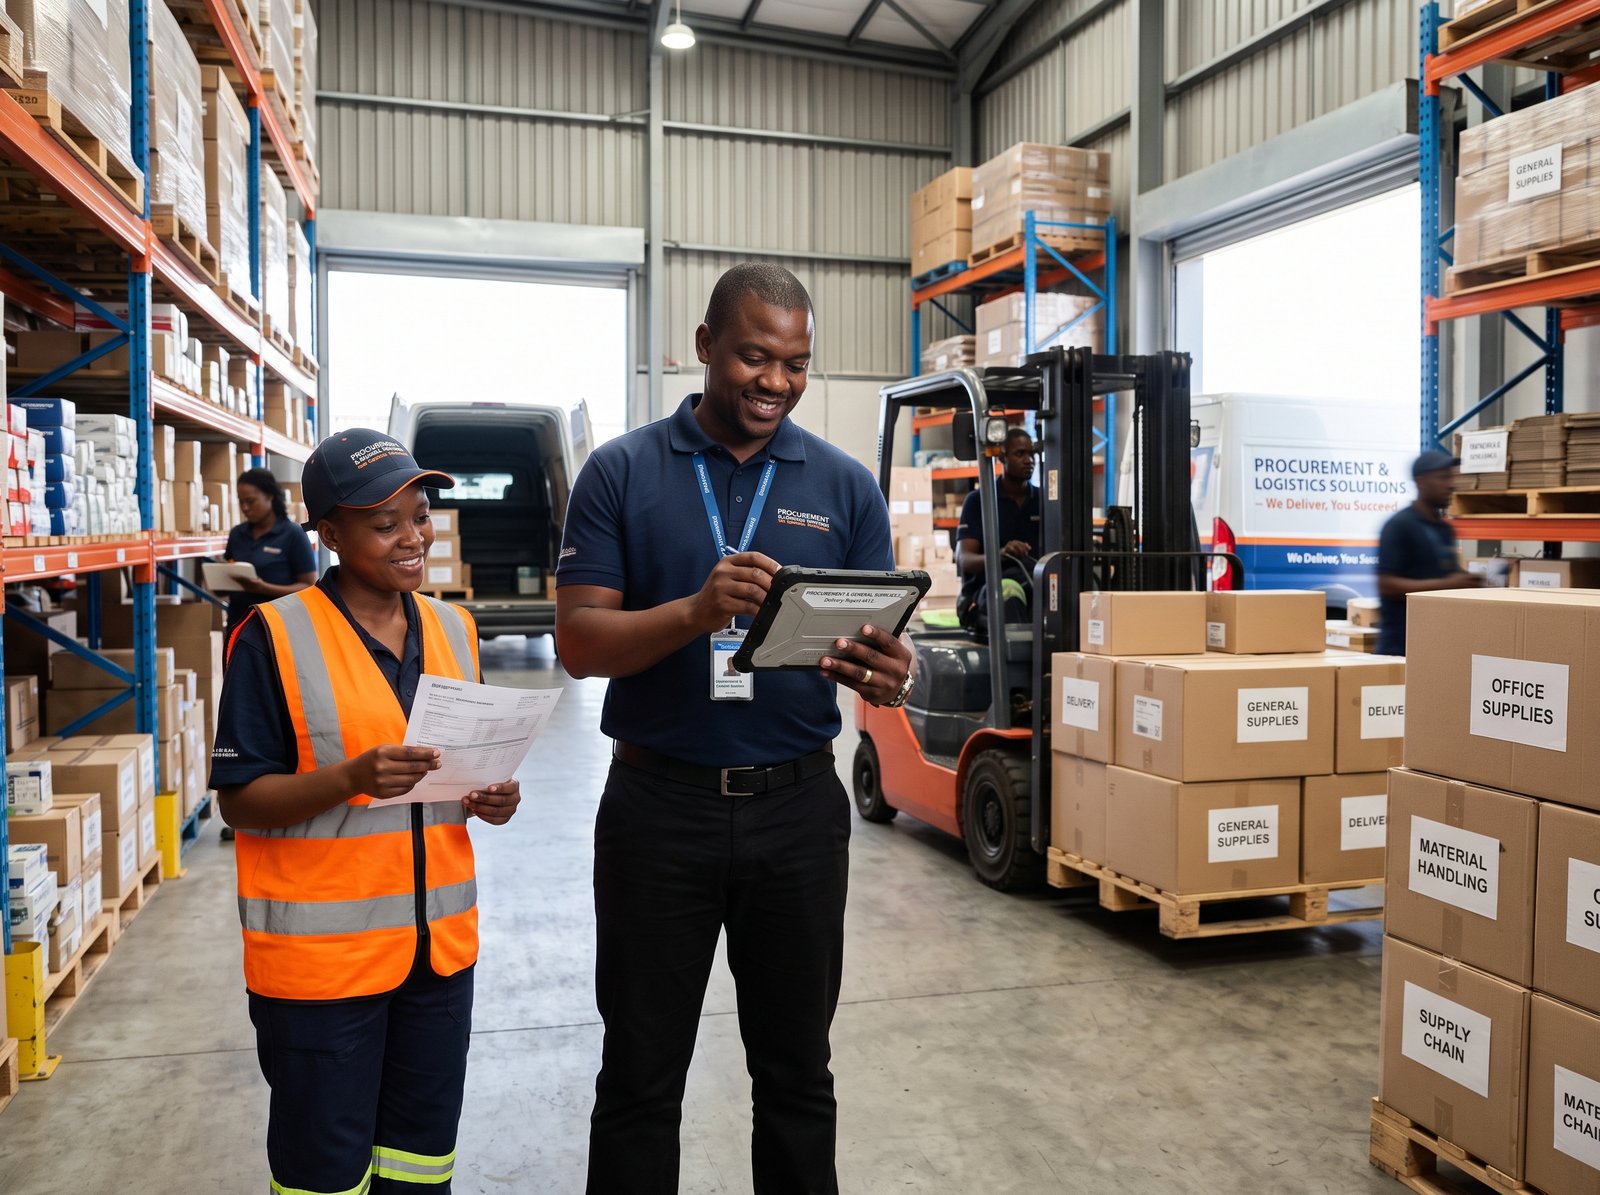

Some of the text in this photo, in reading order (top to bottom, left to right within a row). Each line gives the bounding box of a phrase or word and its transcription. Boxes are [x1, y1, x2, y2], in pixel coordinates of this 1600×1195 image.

[1516, 157, 1554, 175] GENERAL
[1515, 171, 1553, 189] SUPPLIES
[1254, 458, 1389, 476] PROCUREMENT &
[1254, 478, 1407, 494] LOGISTICS SOLUTIONS
[1265, 498, 1283, 509] We
[1286, 498, 1328, 511] Deliver,
[1330, 500, 1350, 511] You
[1354, 500, 1398, 512] Succeed
[777, 508, 830, 523] PROCUREMENT
[1287, 552, 1303, 564] We
[1303, 552, 1340, 565] Deliver,
[1340, 553, 1358, 564] You
[1491, 678, 1545, 700] OFFICE
[1066, 696, 1096, 710] DELIVERY
[1247, 701, 1299, 712] GENERAL
[1482, 699, 1554, 725] SUPPLIES
[1246, 715, 1299, 727] SUPPLIES
[1218, 819, 1270, 833] GENERAL
[1349, 815, 1387, 828] DELIVE
[1217, 833, 1270, 847] SUPPLIES
[1420, 838, 1488, 871] MATERIAL
[1418, 859, 1488, 894] HANDLING
[1419, 1009, 1471, 1043] SUPPLY
[1423, 1032, 1465, 1064] CHAIN
[1563, 1113, 1600, 1142] CHAI
